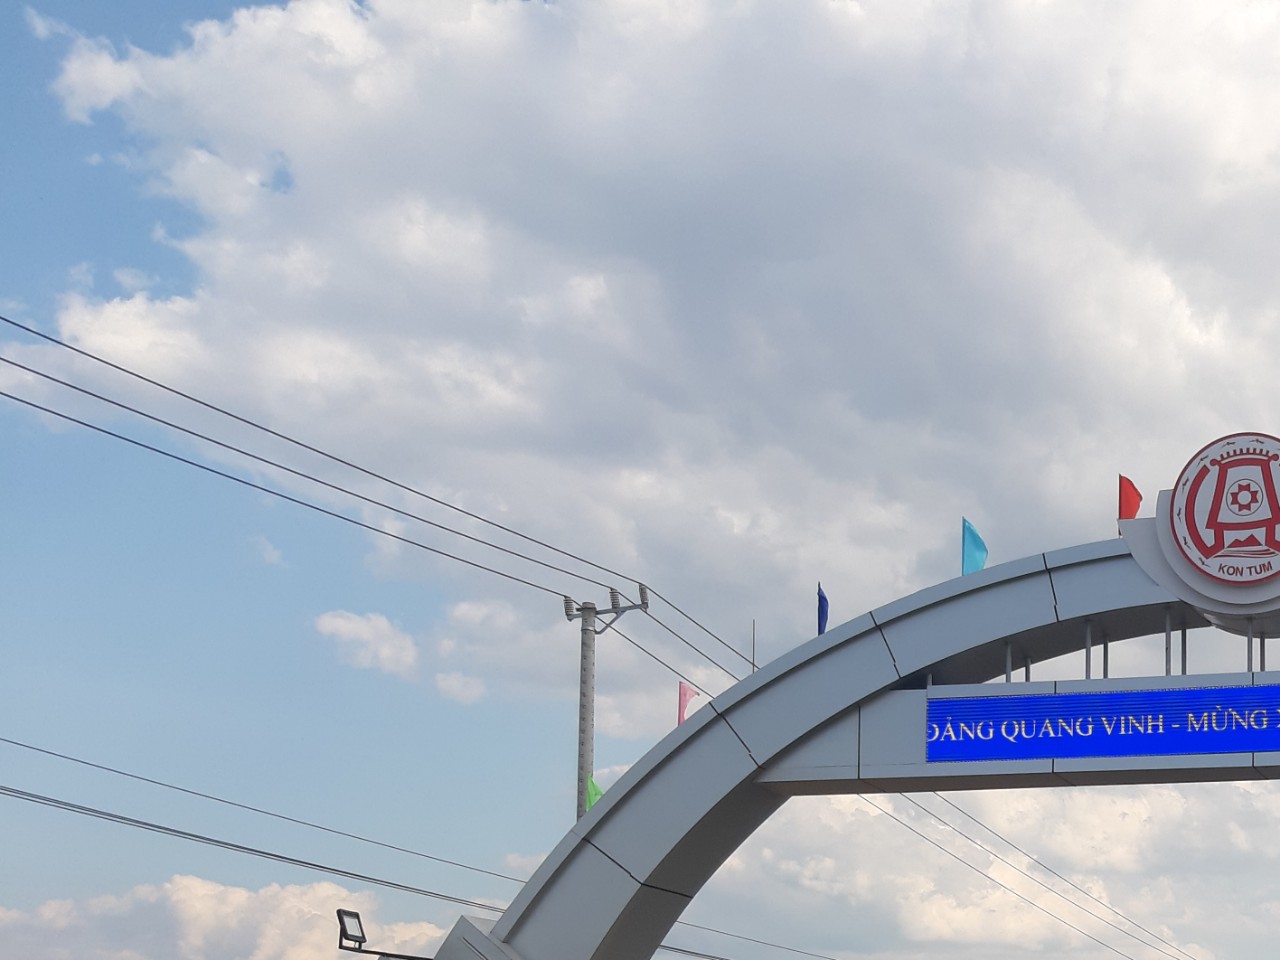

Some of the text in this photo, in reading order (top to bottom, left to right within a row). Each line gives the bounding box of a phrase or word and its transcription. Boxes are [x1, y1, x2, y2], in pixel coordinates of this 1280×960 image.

[1218, 560, 1273, 577] KON TUM
[1000, 716, 1095, 743] QUANG
[1100, 714, 1165, 736] VINH
[1186, 705, 1269, 732] MỪNG
